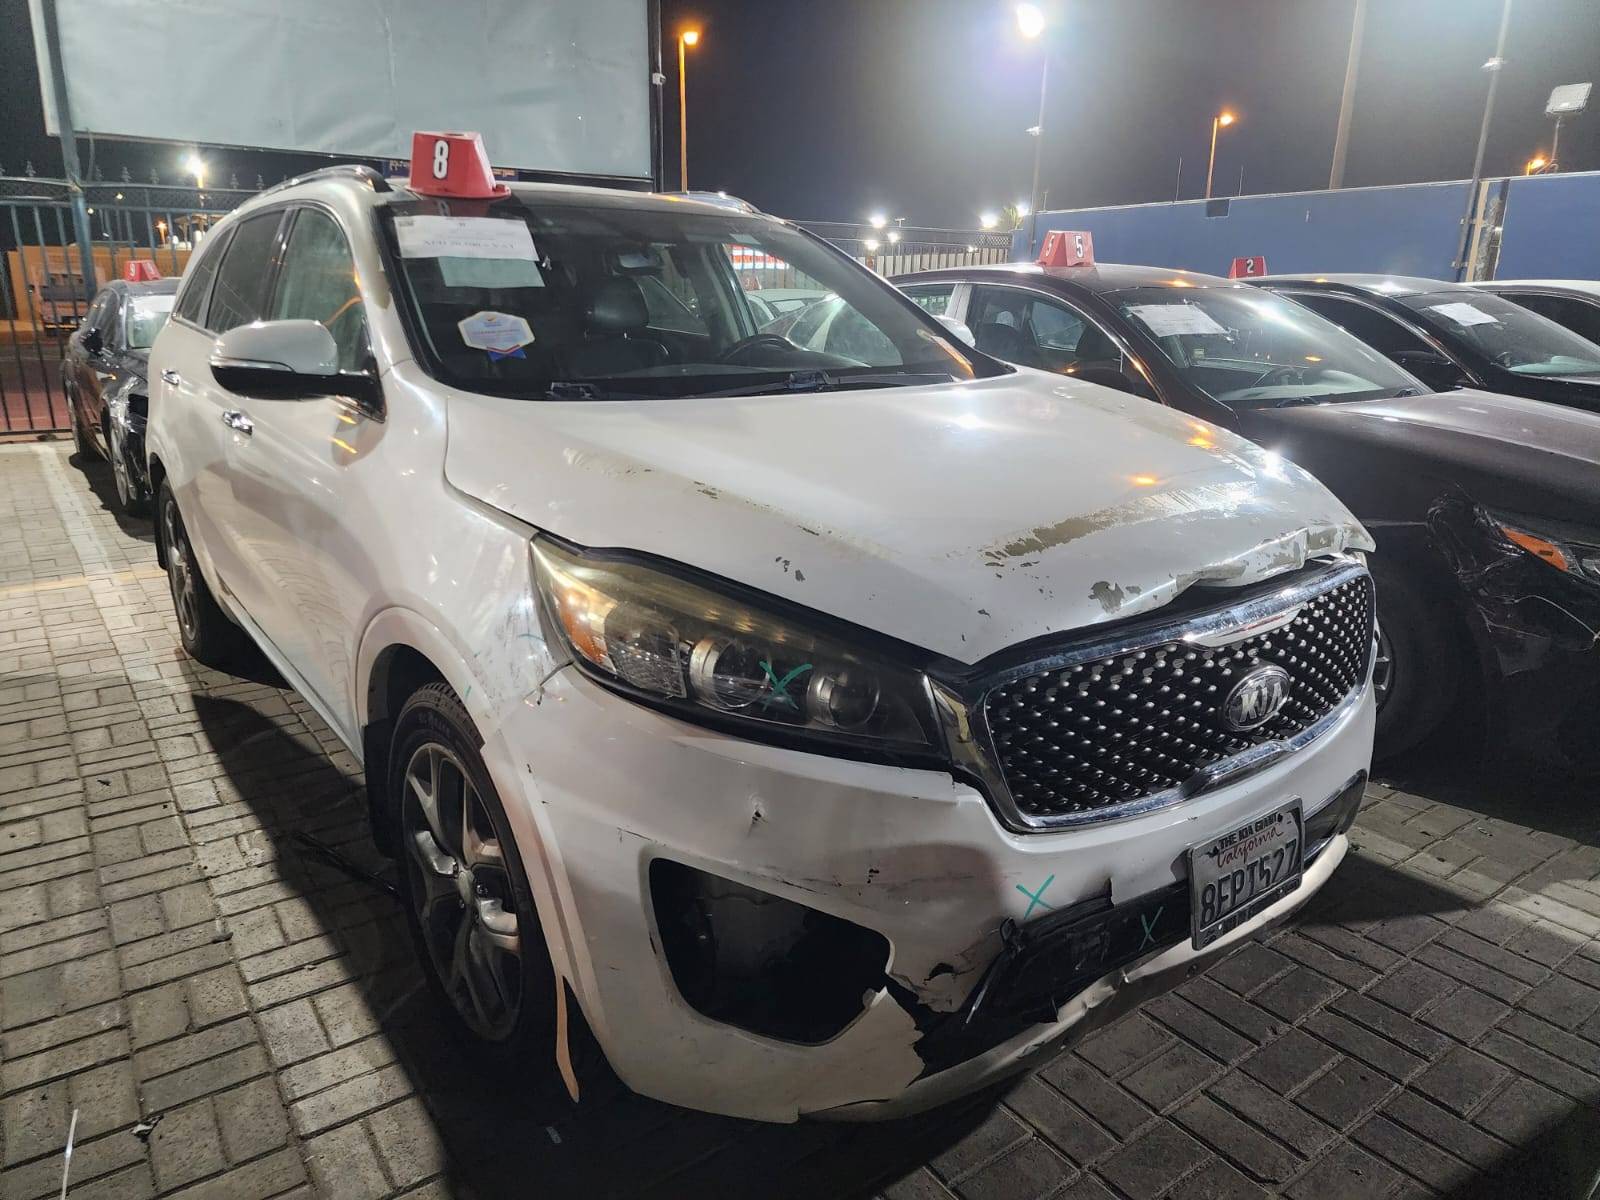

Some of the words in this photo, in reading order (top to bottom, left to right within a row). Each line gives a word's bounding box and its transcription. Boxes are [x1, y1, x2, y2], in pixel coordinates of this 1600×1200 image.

[434, 140, 449, 179] 8
[1075, 236, 1084, 258] 5
[1247, 259, 1254, 274] 2
[1240, 682, 1284, 722] KIA
[1217, 826, 1284, 868] California
[1219, 834, 1237, 849] THE
